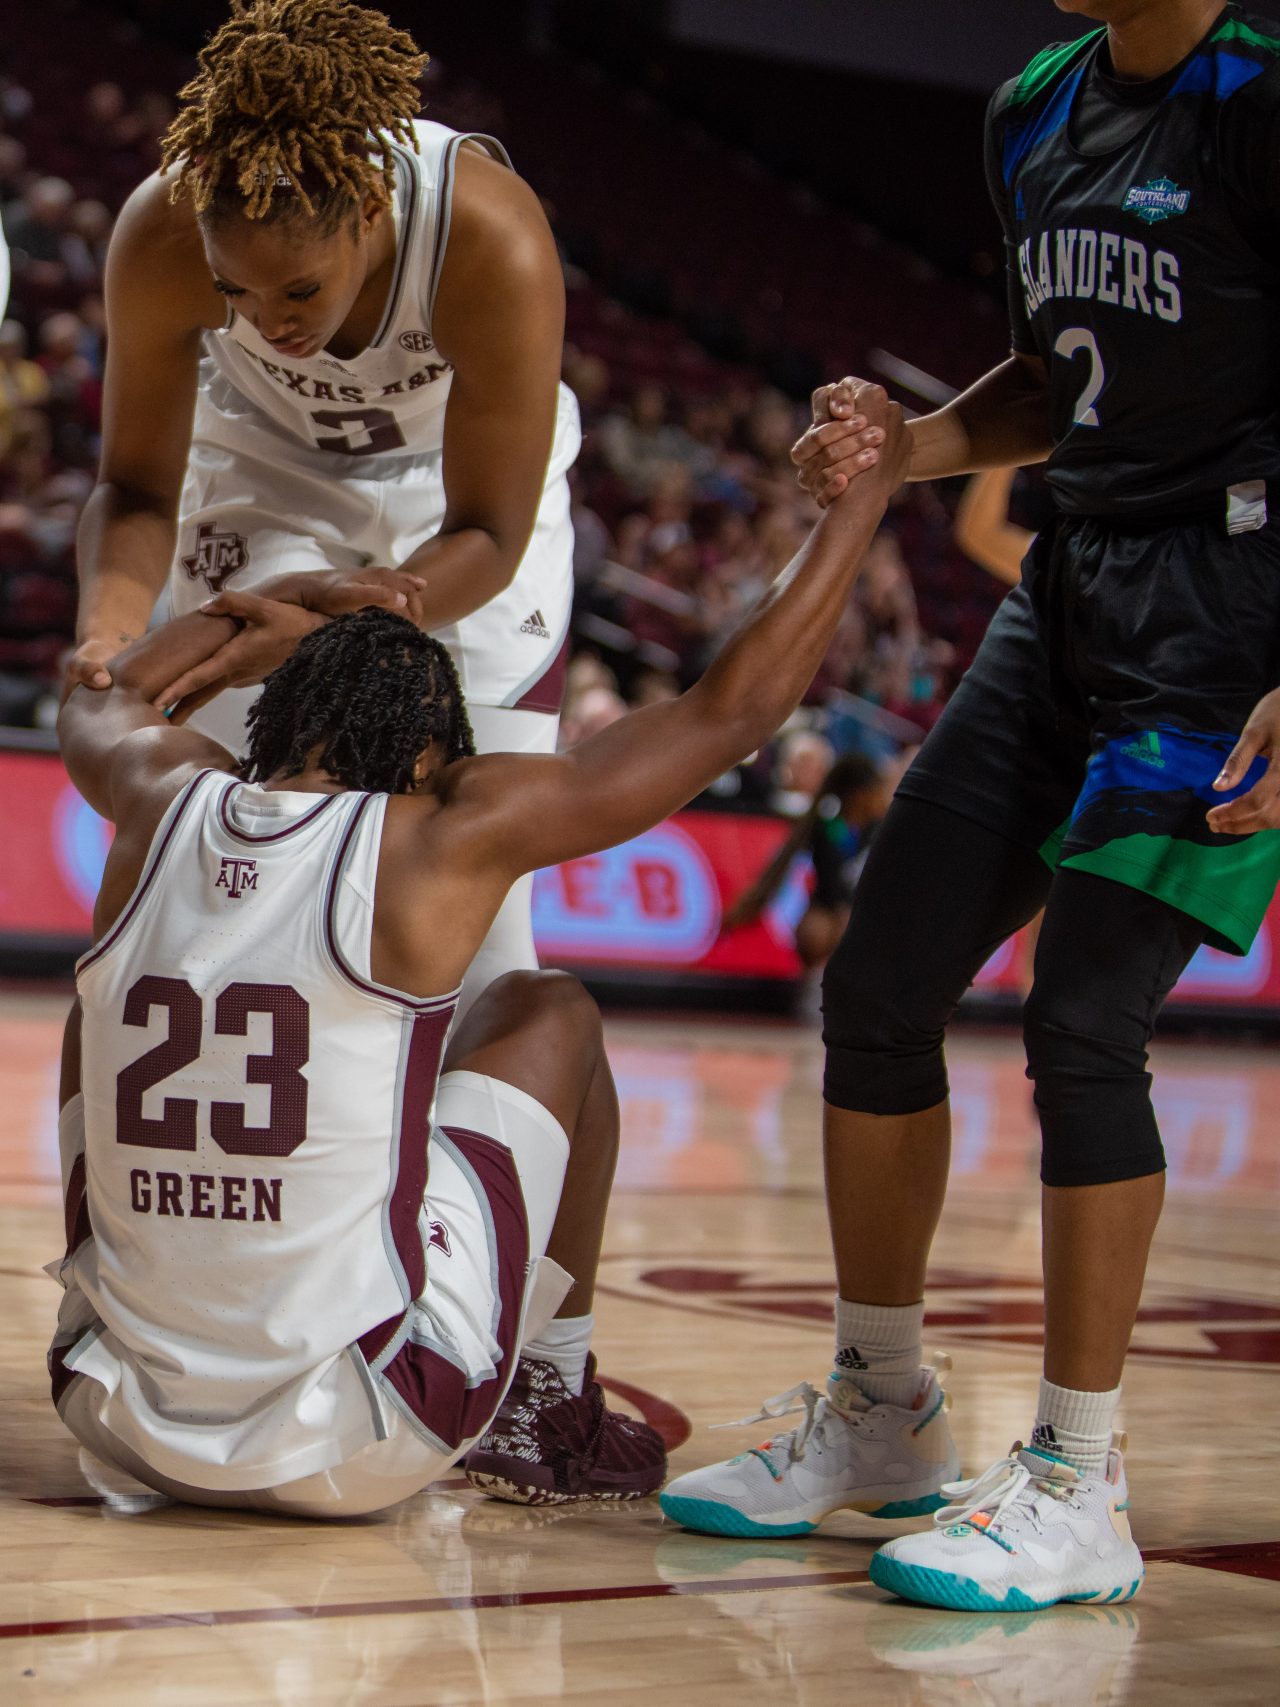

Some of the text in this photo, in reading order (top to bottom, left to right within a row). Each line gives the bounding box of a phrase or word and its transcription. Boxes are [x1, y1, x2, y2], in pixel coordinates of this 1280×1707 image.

[1126, 189, 1188, 210] SOUTHLAND
[1019, 229, 1182, 323] SLANDERS
[401, 335, 433, 350] SEC
[1054, 327, 1105, 427] 2
[116, 974, 310, 1158] 23
[130, 1169, 282, 1222] GREEN
[517, 1446, 542, 1463] OWN
